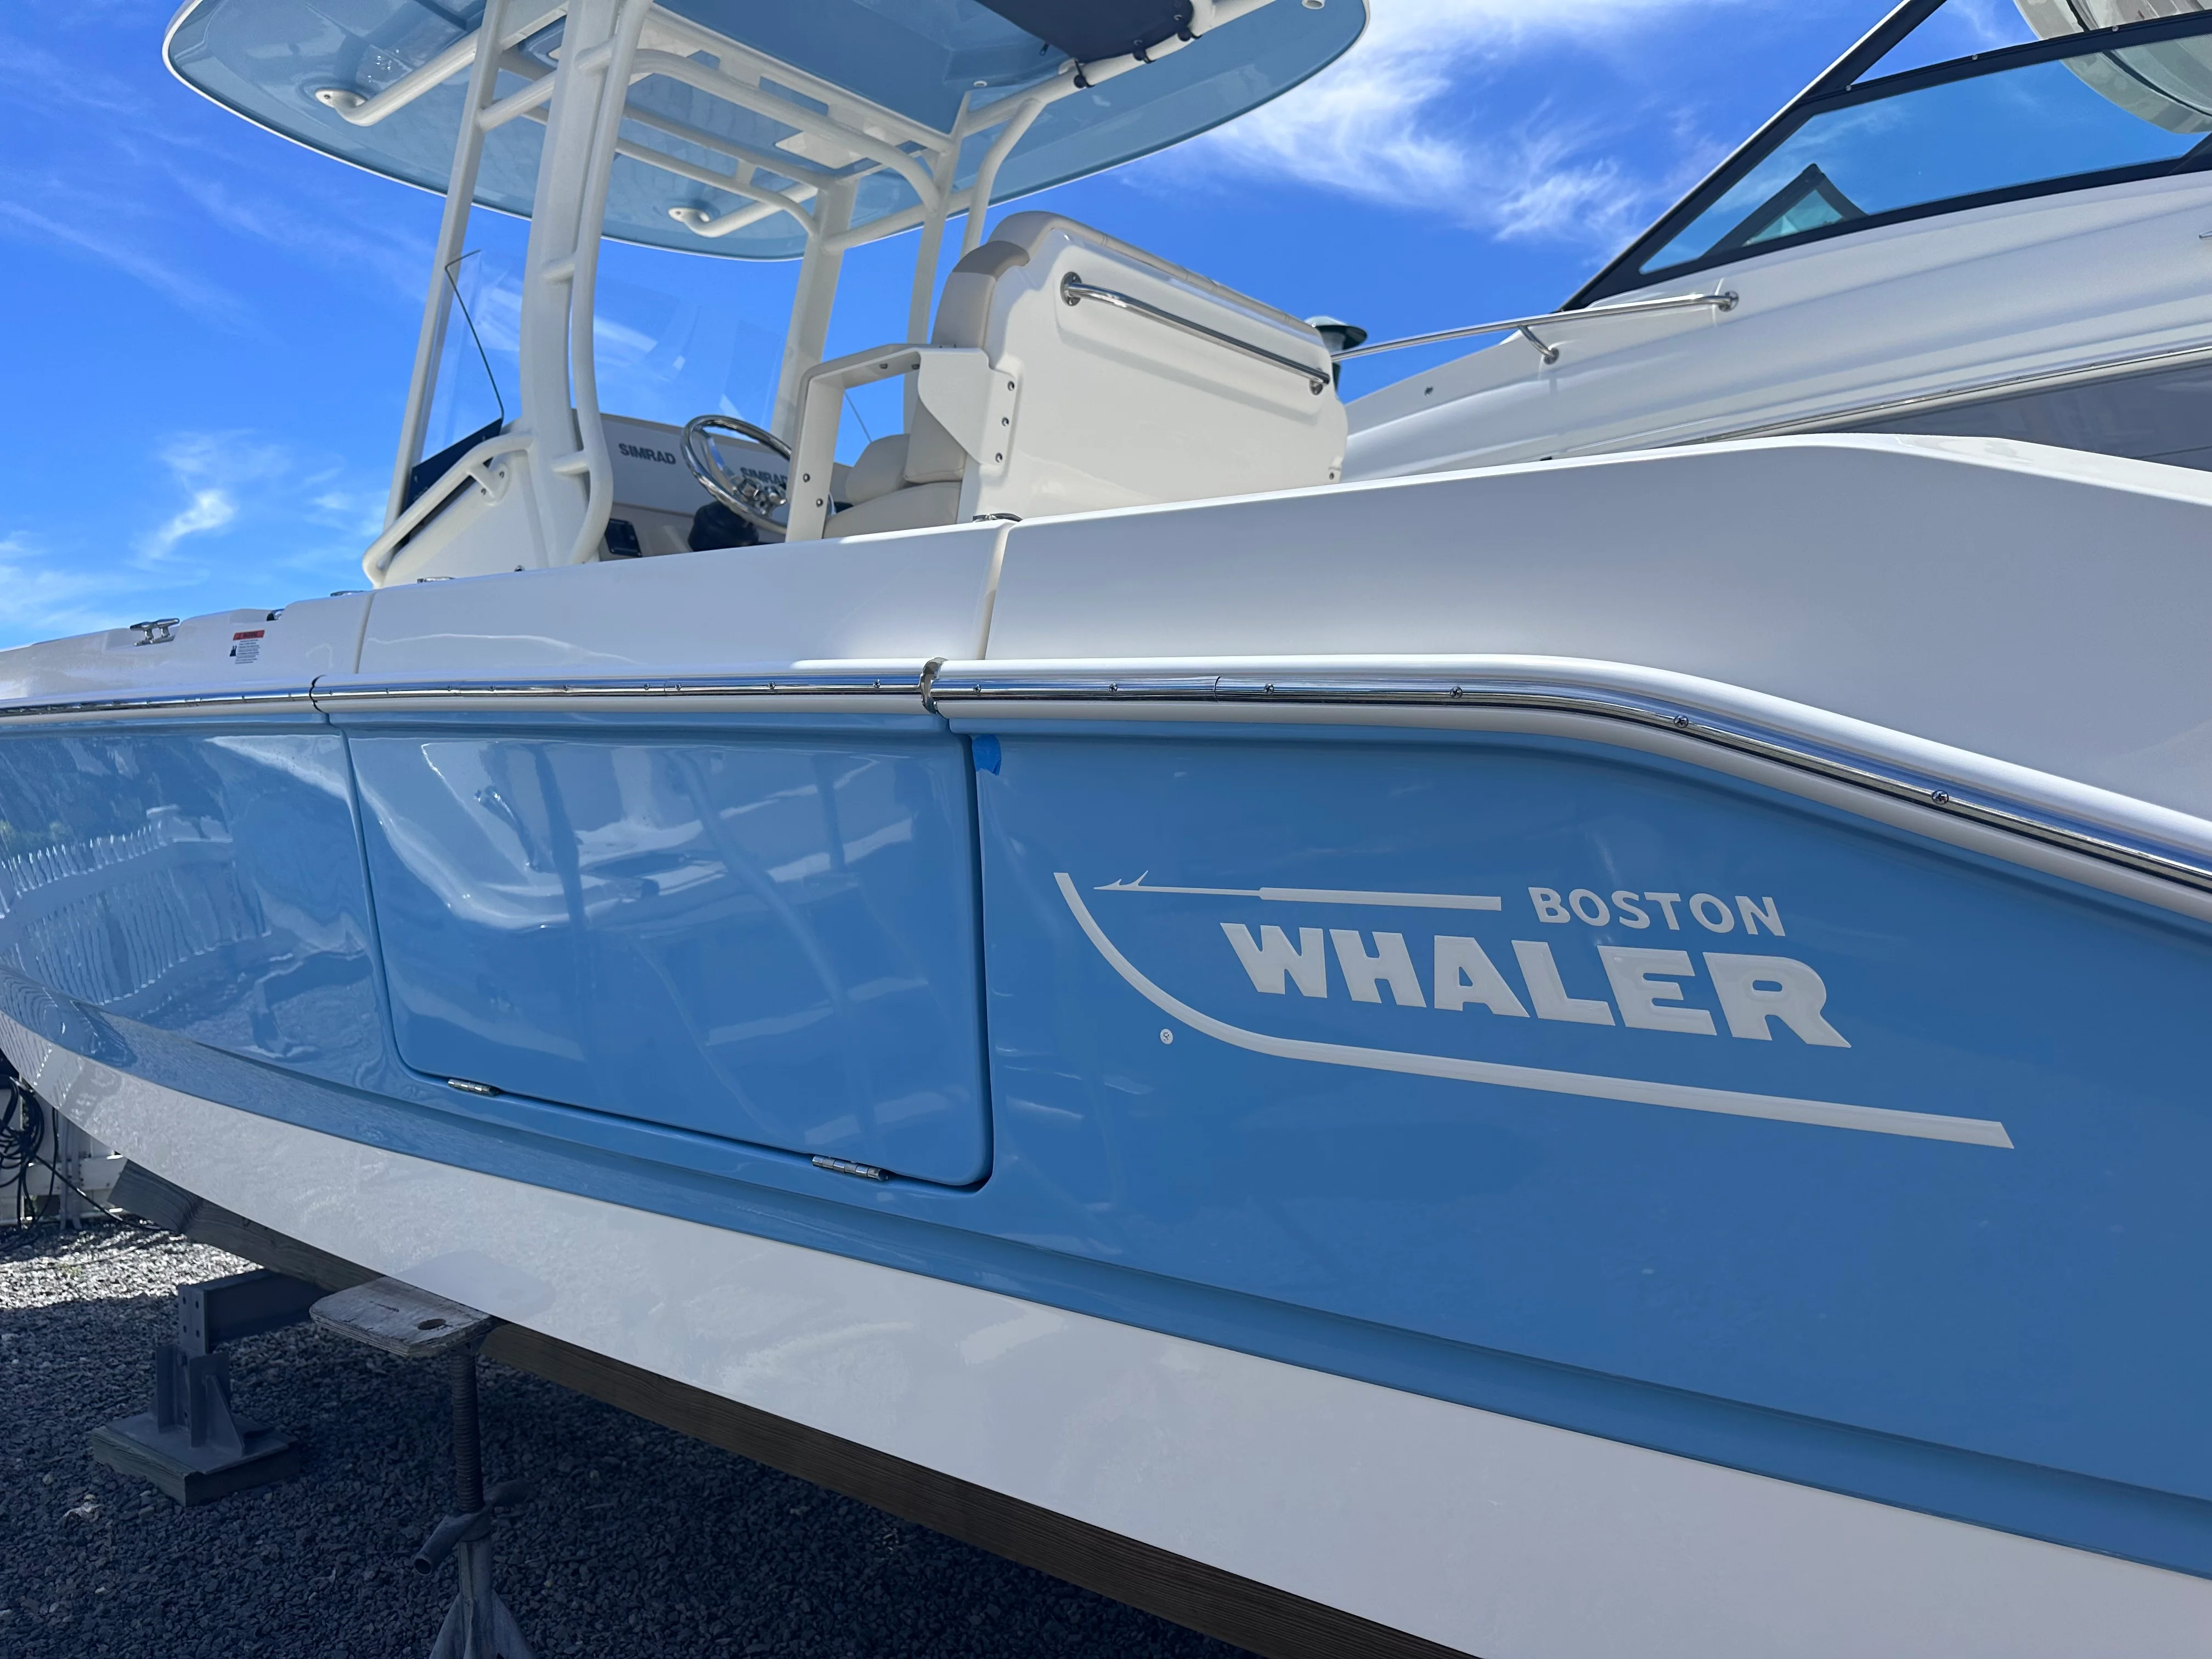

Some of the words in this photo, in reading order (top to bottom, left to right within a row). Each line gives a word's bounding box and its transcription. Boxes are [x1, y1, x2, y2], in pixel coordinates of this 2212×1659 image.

[618, 443, 676, 465] SIMRAD
[1528, 887, 1786, 936] BOSTON
[1220, 922, 1852, 1048] WHALER
